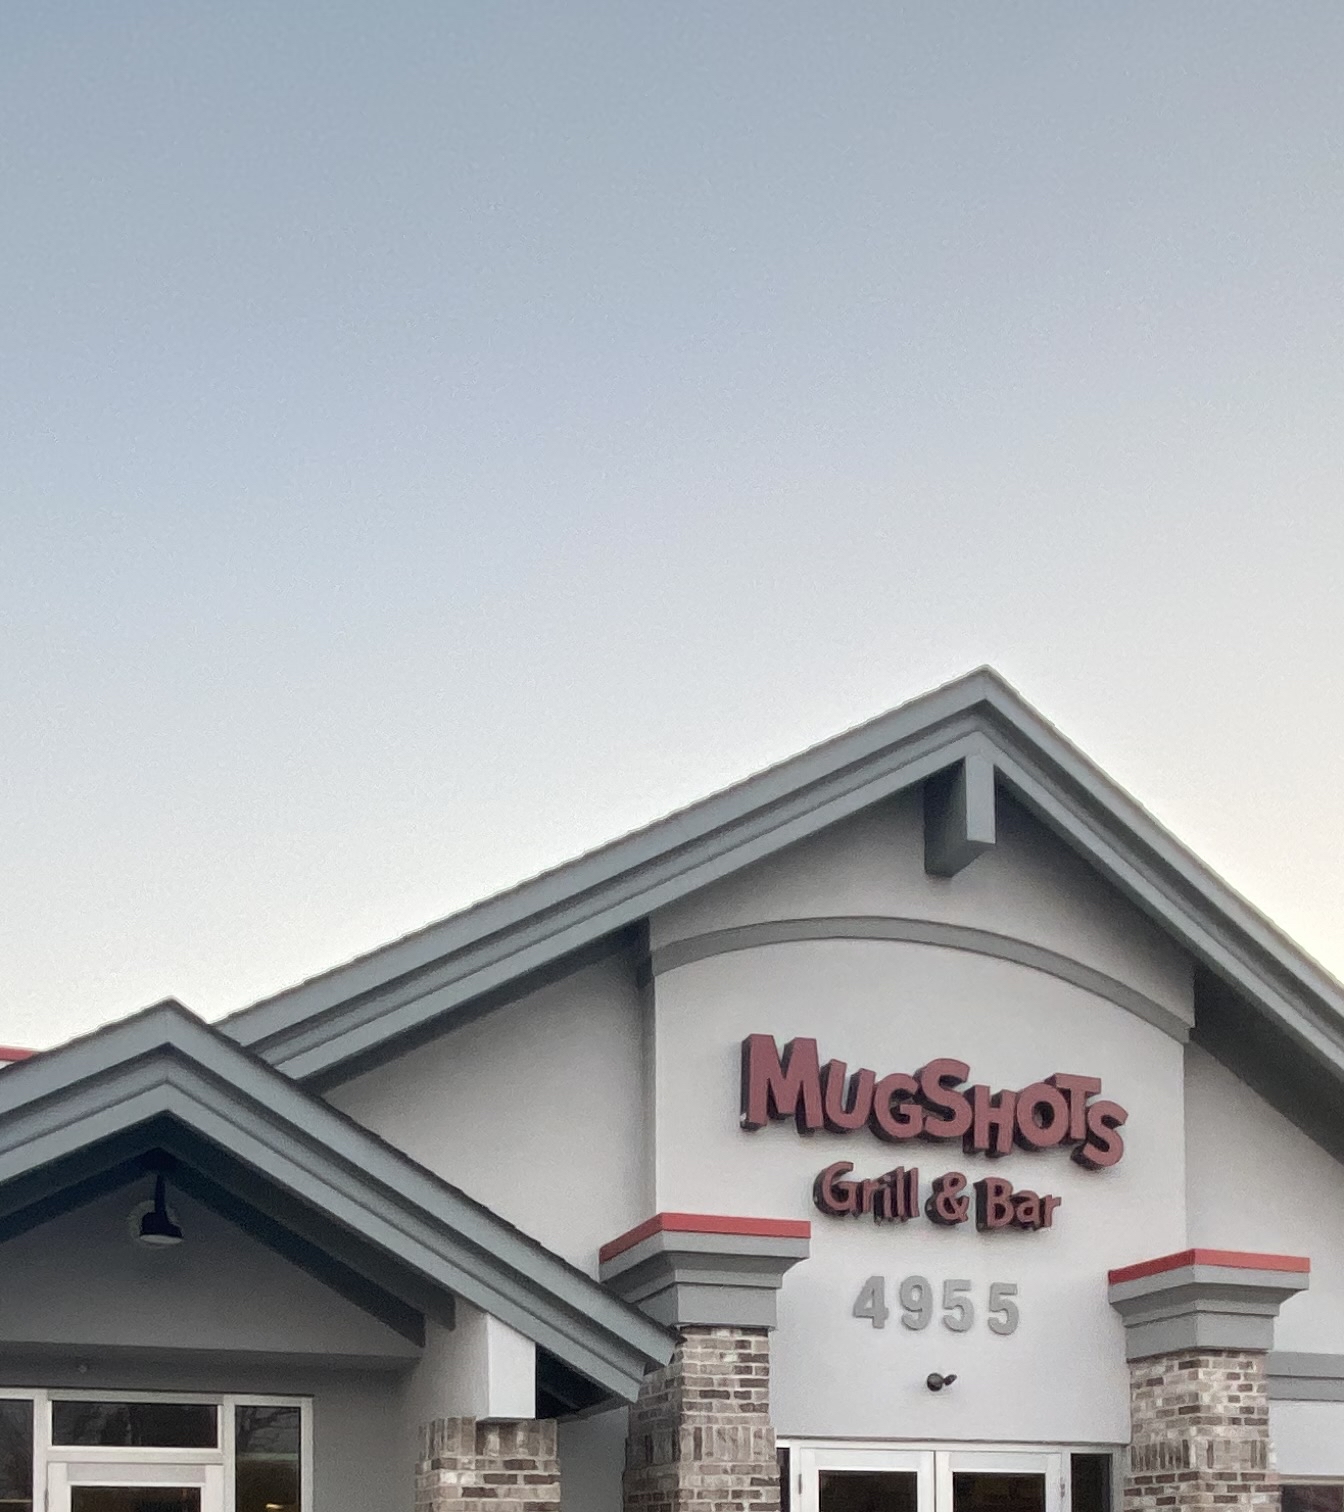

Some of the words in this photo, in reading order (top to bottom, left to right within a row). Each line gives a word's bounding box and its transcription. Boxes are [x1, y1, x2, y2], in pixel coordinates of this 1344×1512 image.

[813, 1161, 920, 1225] Grill
[925, 1171, 970, 1226] &
[973, 1176, 1062, 1233] Bar
[852, 1275, 1020, 1336] 4955
